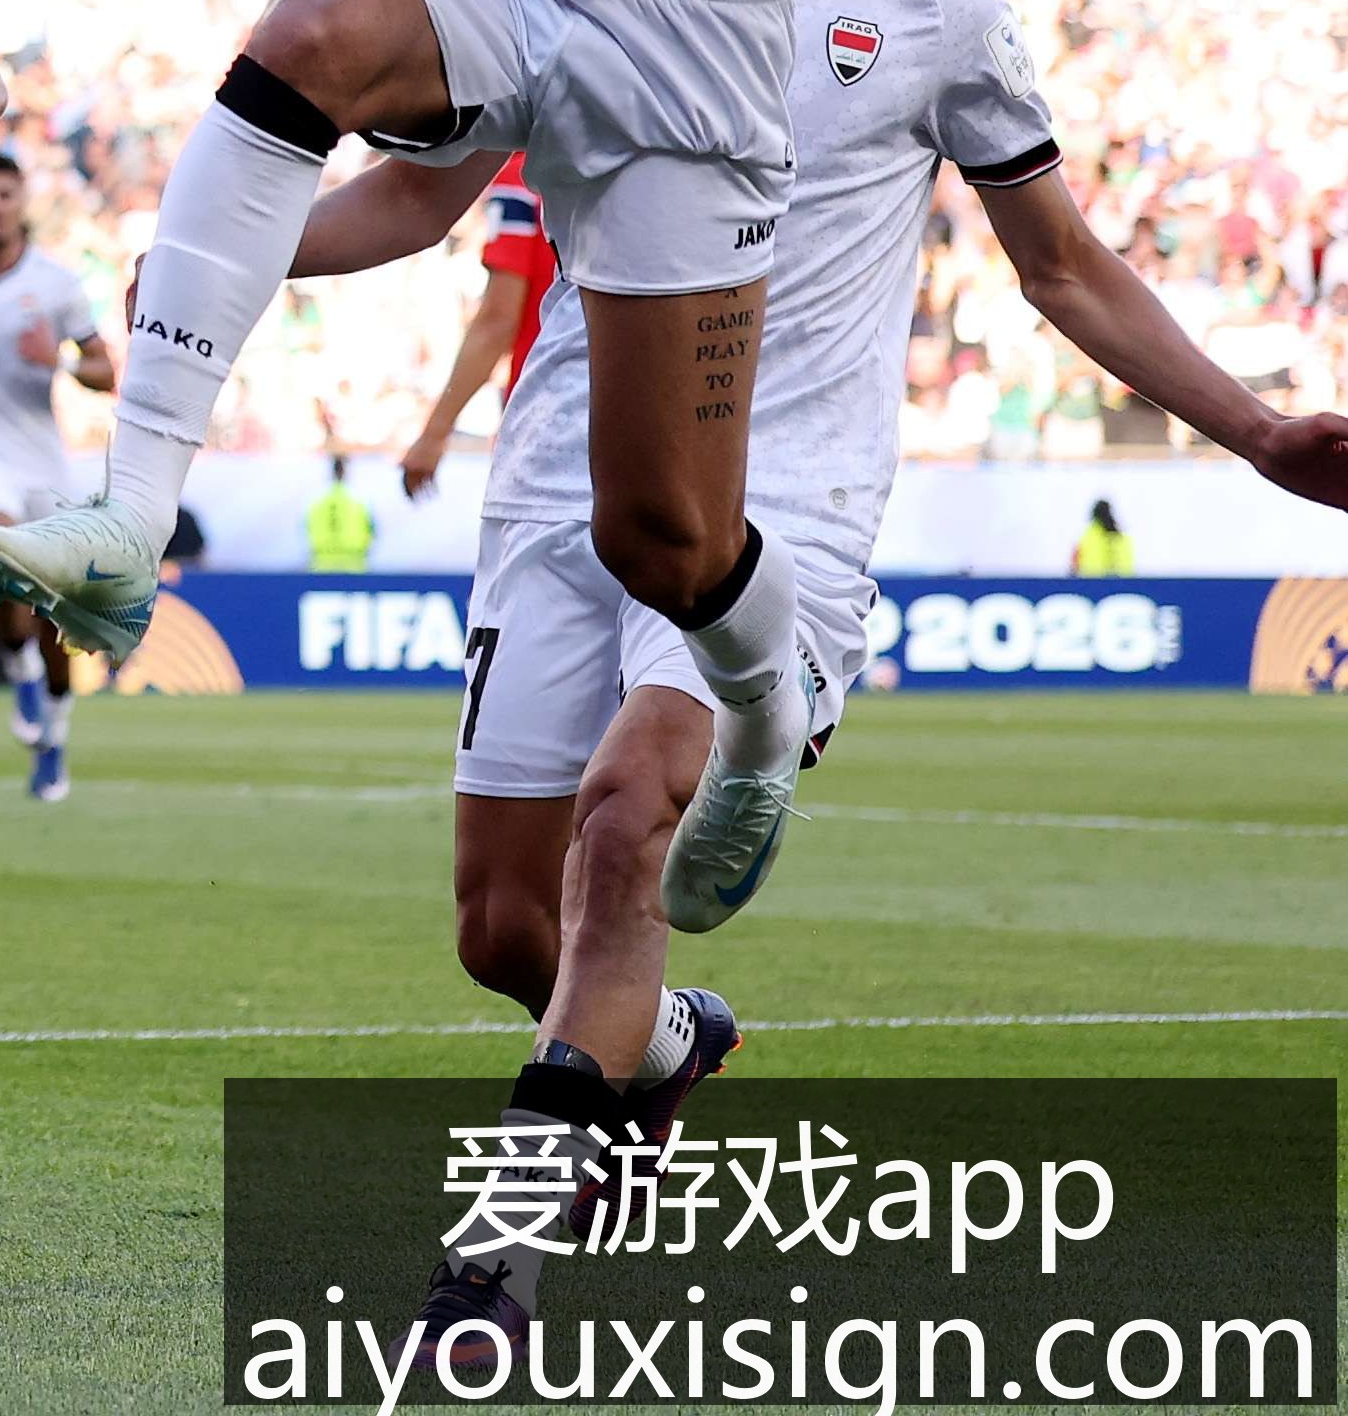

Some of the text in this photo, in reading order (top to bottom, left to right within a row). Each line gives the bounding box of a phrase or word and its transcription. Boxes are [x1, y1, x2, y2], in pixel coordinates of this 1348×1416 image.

[840, 21, 872, 35] IRAQ
[734, 218, 775, 250] JAKO
[697, 310, 754, 333] GAME
[135, 314, 213, 359] JAKO
[696, 340, 749, 363] PLAY
[706, 373, 734, 390] TO
[696, 401, 736, 423] WIN
[298, 590, 466, 671] FIFA
[905, 592, 1159, 672] 2026
